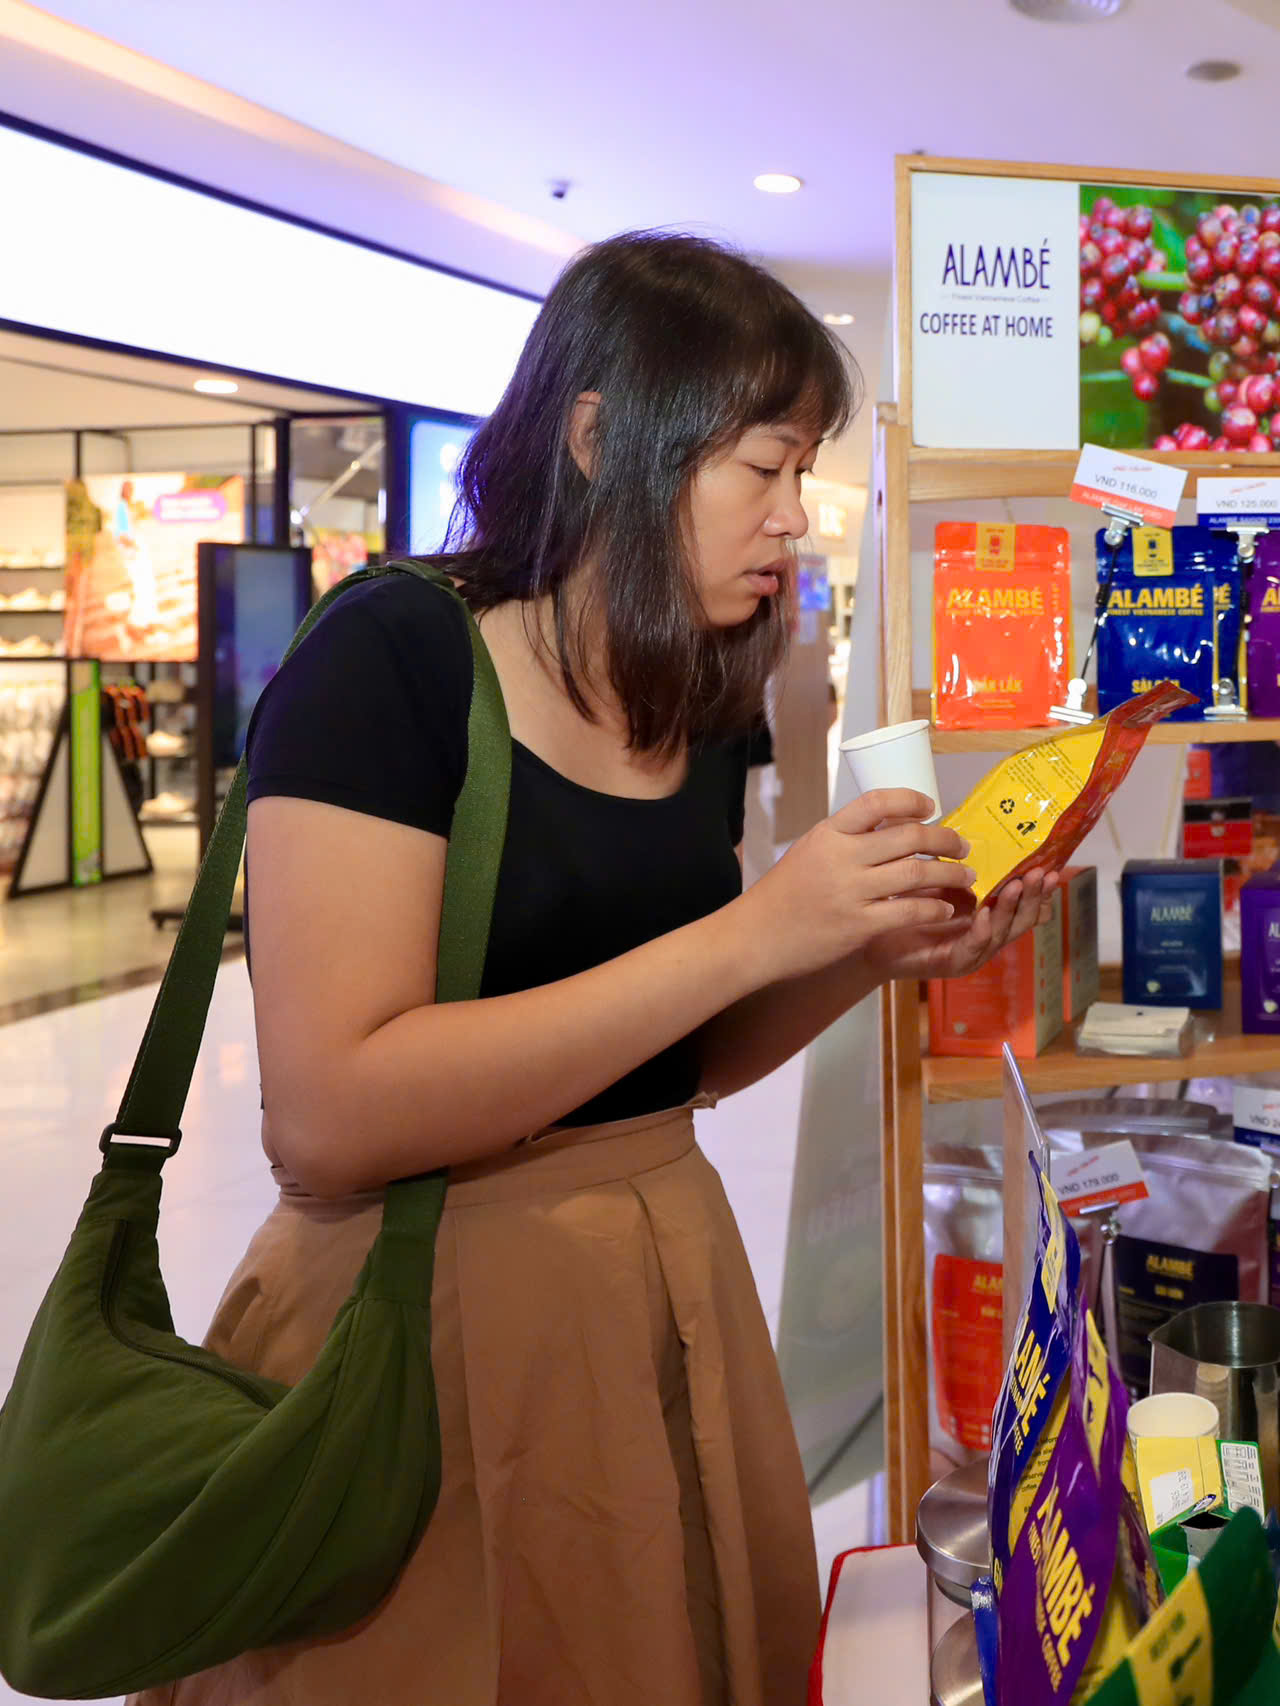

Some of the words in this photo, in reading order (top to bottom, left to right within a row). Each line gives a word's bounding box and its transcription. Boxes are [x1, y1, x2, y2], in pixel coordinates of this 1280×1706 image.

[942, 237, 1050, 289] ALAMBÉ
[919, 312, 977, 335] COFFEE
[981, 314, 1001, 336] AT
[1005, 315, 1053, 338] HOME
[1095, 474, 1117, 487] VND
[1120, 481, 1158, 499] 116.000
[1216, 499, 1237, 509] VND
[1240, 499, 1279, 509] 125.000
[946, 586, 1044, 609] ALAMBÉ
[1106, 583, 1205, 609] ALAMBÉ
[1249, 1114, 1271, 1127] VND
[1058, 1182, 1080, 1195] VND
